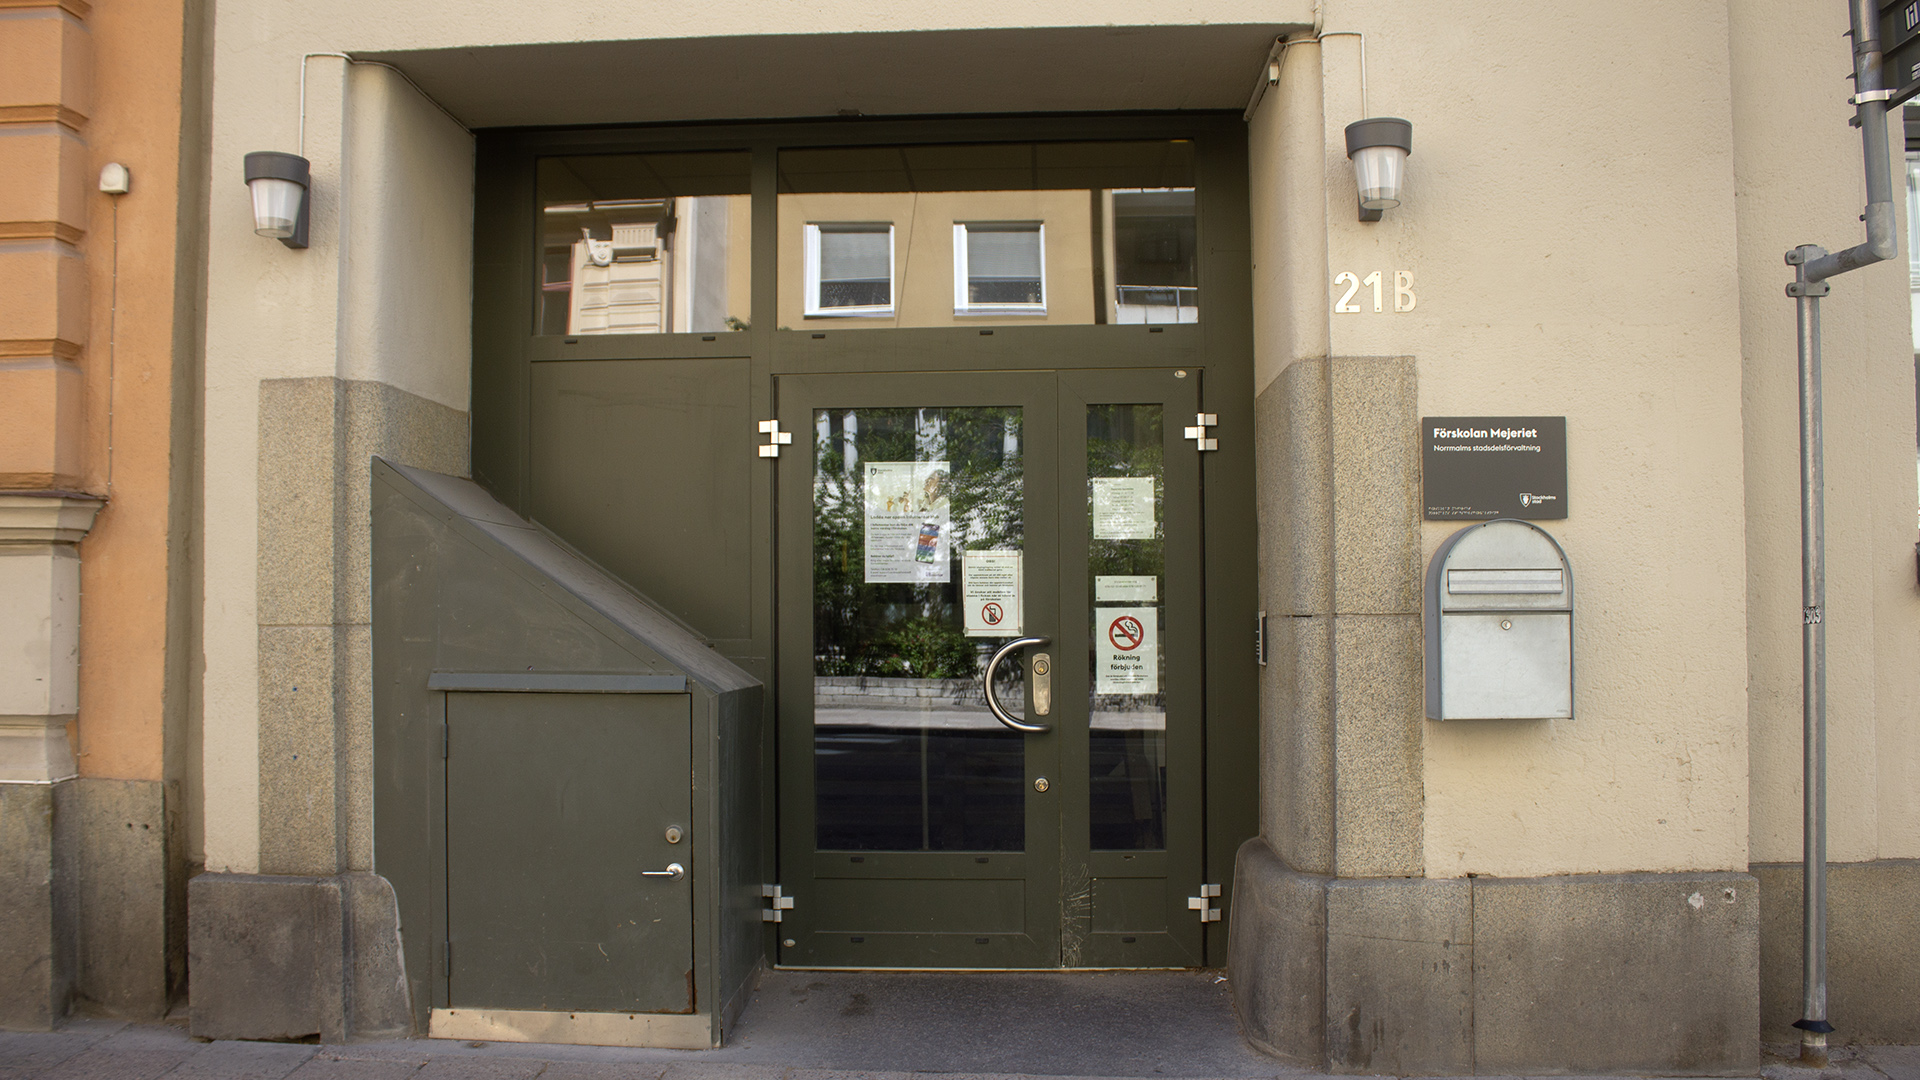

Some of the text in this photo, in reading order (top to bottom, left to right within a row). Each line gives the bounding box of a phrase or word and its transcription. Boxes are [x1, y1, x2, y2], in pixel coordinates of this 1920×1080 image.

[1433, 428, 1538, 440] Förskolan Mejeriet
[1472, 444, 1542, 453] stadsdelsförvaltning
[1113, 654, 1141, 662] Rökning
